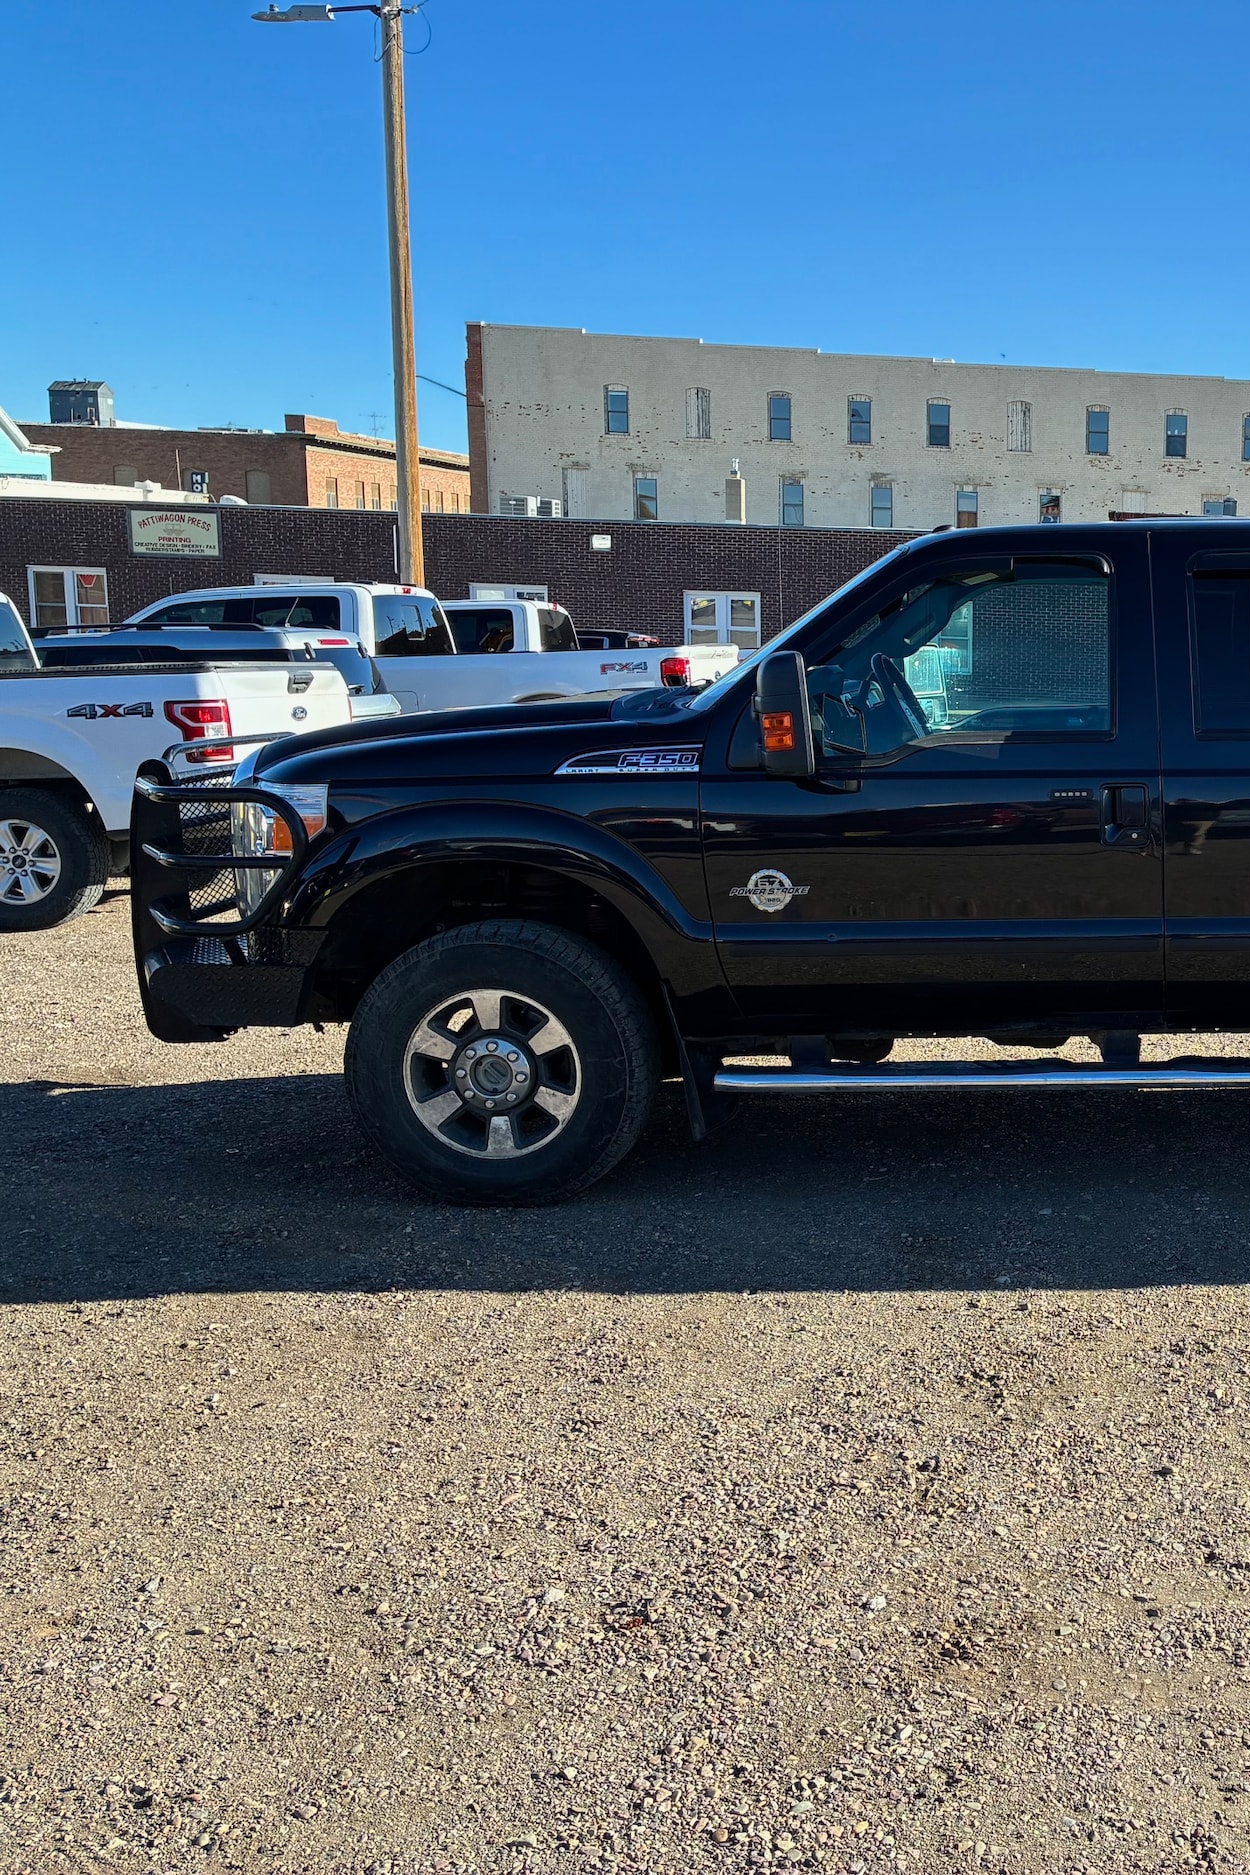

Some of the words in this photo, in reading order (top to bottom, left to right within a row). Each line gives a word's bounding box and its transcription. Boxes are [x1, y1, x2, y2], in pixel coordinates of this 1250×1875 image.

[138, 513, 186, 529] PATTIWAGON
[187, 516, 212, 532] PRESS
[601, 662, 648, 674] FX4
[729, 887, 766, 896] POWER
[767, 886, 811, 896] STROKE
